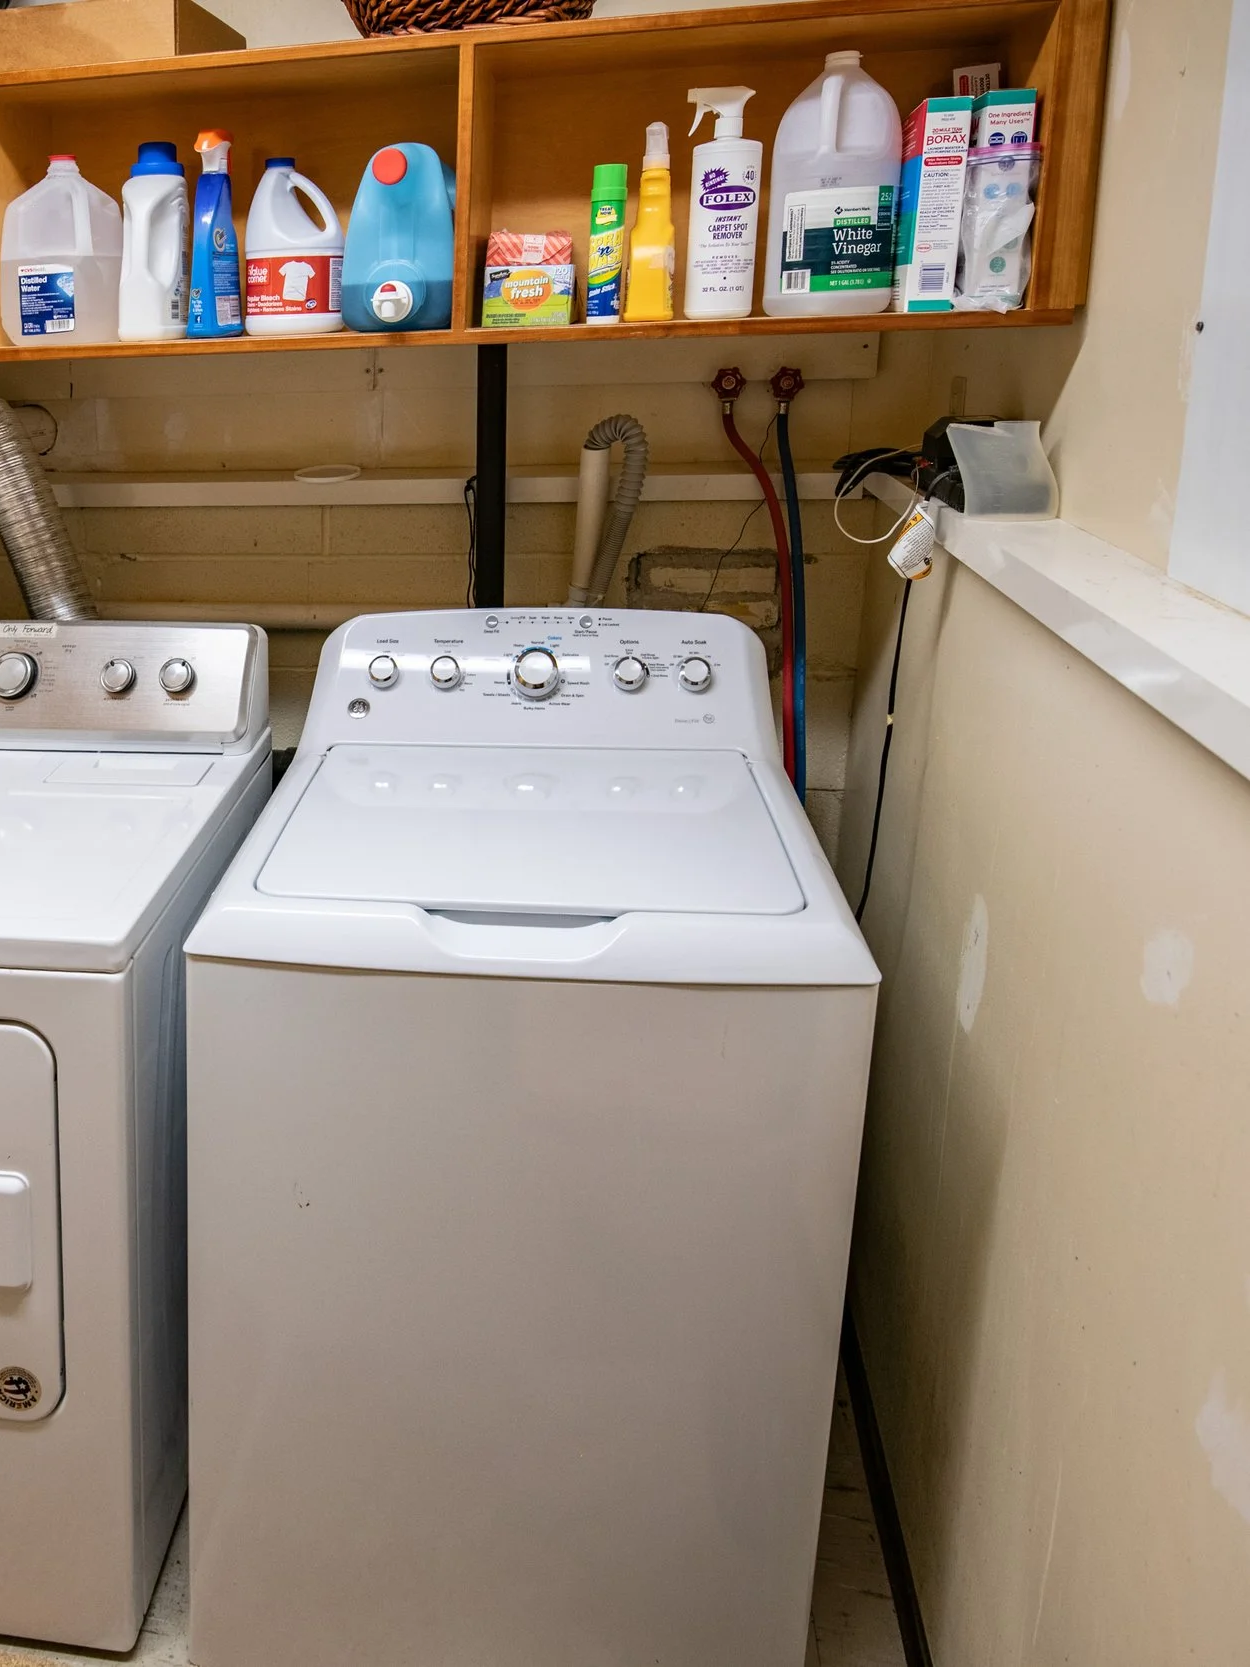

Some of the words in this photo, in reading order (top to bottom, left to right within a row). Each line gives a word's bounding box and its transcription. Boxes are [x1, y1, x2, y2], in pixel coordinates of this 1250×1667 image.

[1001, 111, 1033, 119] Ingredient,
[926, 134, 967, 146] BORAX
[745, 170, 755, 181] 40
[705, 192, 751, 205] FOLEX
[715, 215, 742, 223] INSTANT
[836, 217, 870, 226] DISTILLED
[708, 224, 732, 232] CARPET
[733, 223, 748, 231] SPOT
[712, 231, 743, 240] REMOVER
[833, 228, 874, 242] White
[832, 243, 882, 256] Vinegar
[20, 276, 48, 285] Distilled
[505, 276, 549, 288] mountain
[20, 285, 41, 293] Water
[511, 286, 544, 300] fresh
[2, 624, 18, 634] Only
[22, 623, 54, 634] Forward
